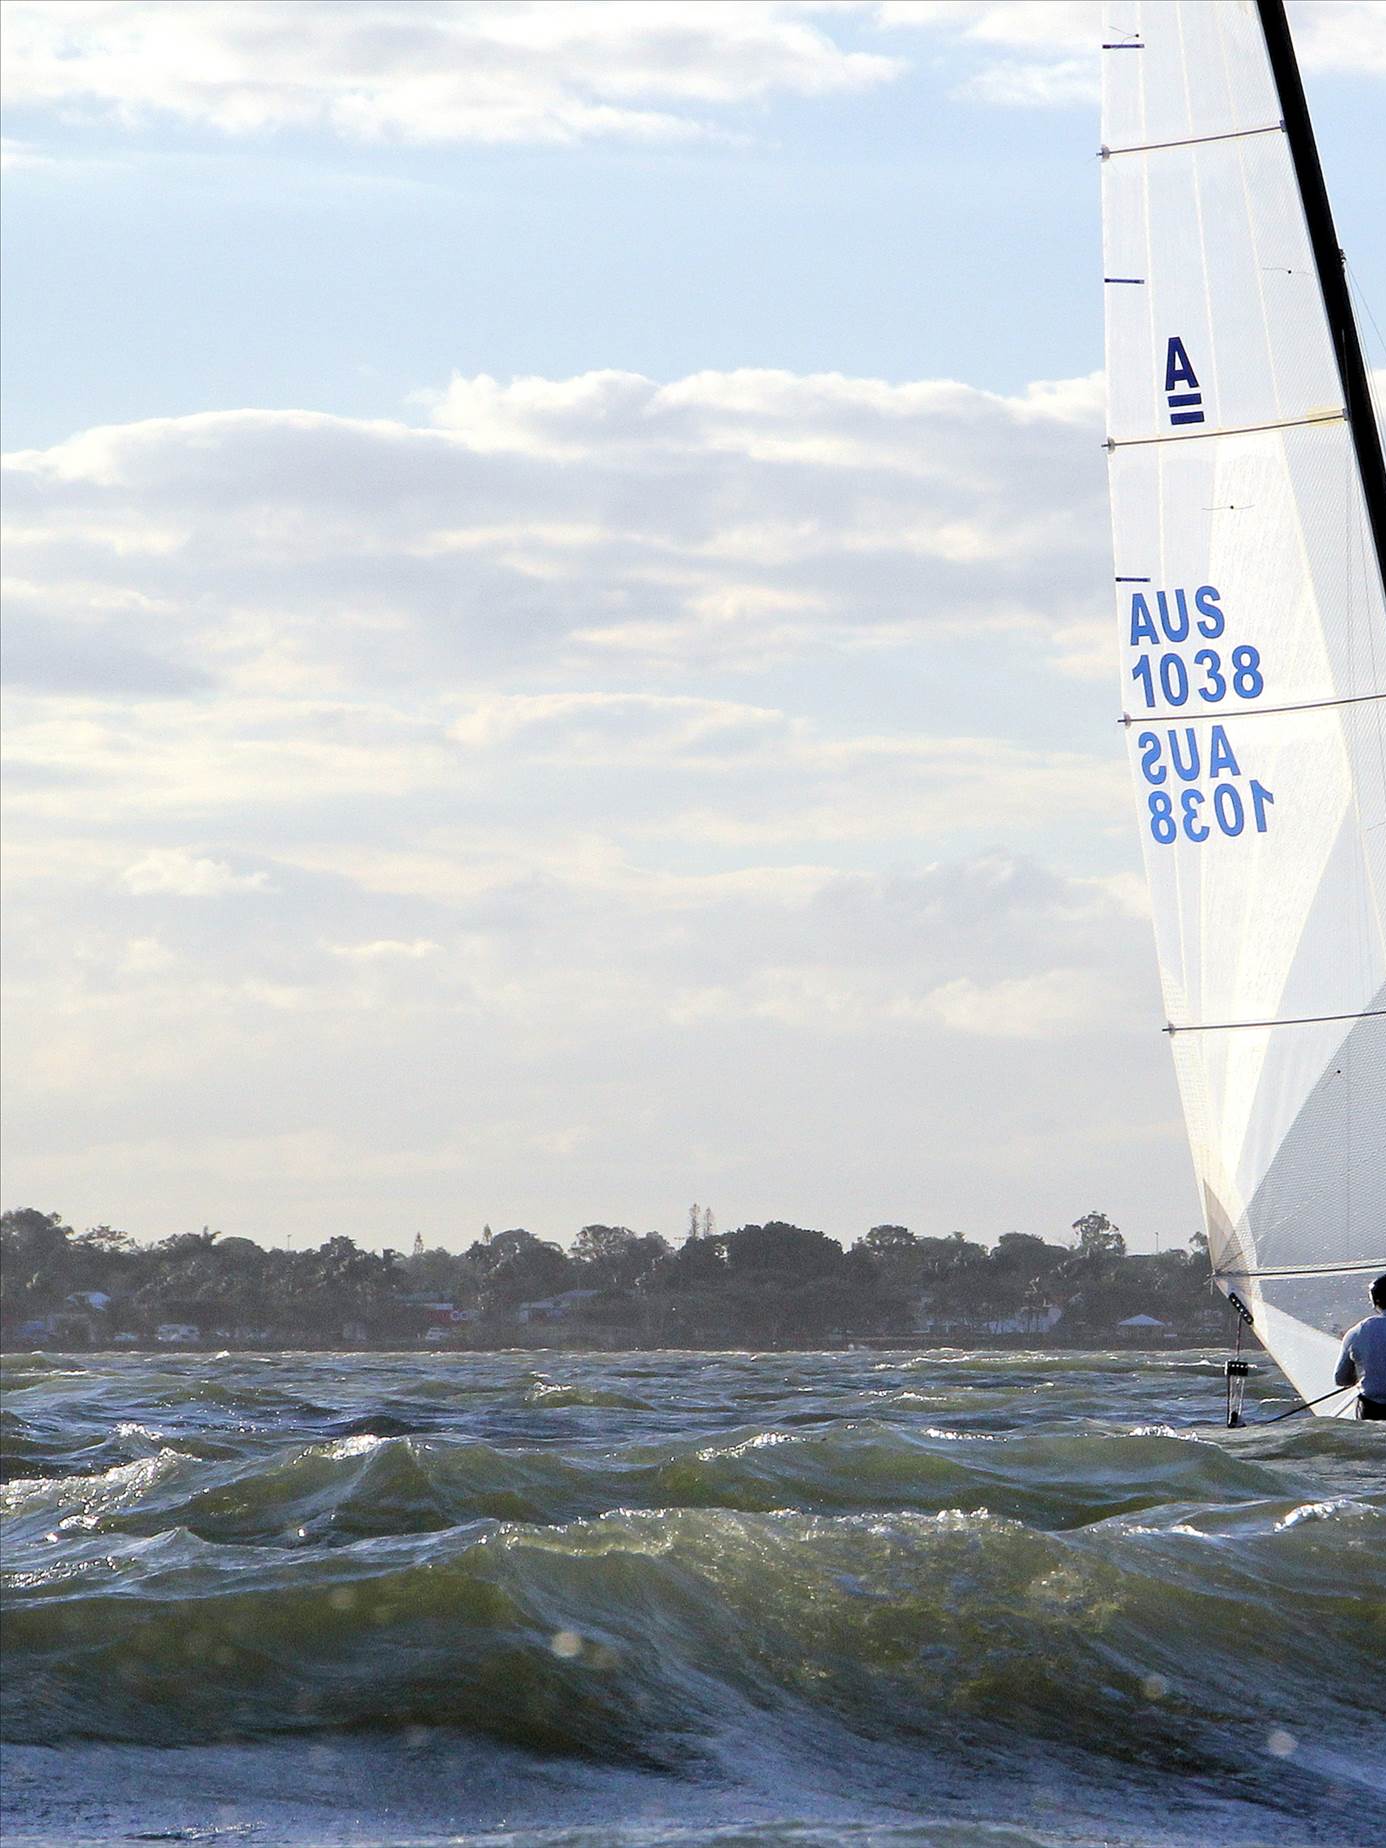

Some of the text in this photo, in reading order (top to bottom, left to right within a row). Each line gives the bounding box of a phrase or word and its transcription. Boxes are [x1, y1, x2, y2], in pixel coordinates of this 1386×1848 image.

[1165, 336, 1199, 391] A
[1130, 586, 1225, 646] AUS
[1132, 645, 1264, 708] 1038
